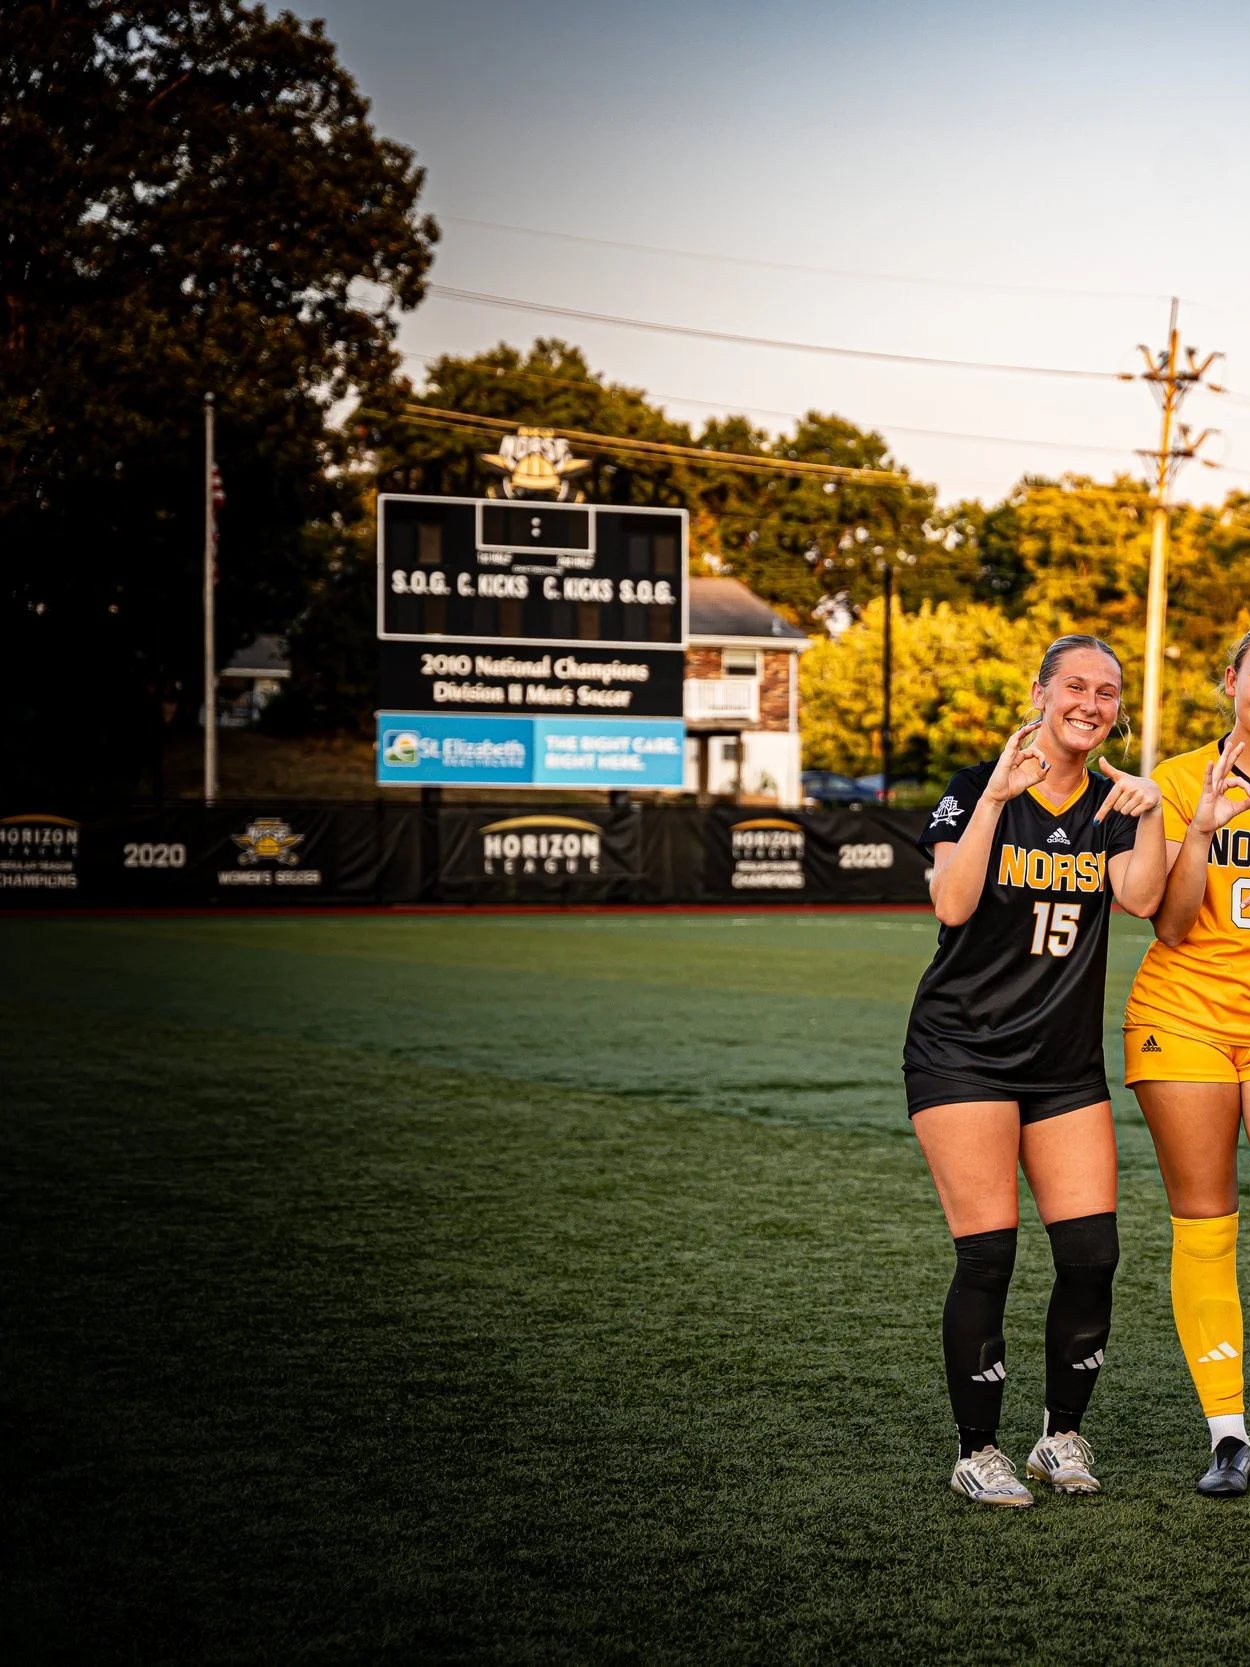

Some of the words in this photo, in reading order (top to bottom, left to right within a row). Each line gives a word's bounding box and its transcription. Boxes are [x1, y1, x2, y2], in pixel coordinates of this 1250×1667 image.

[478, 574, 529, 599] KICKS
[563, 577, 613, 602] KICKS
[421, 654, 472, 675] 2010
[475, 655, 551, 678] National
[554, 656, 649, 685] Champions
[433, 681, 505, 703] Division
[577, 685, 632, 707] Soccer
[484, 834, 600, 858] HORIZON
[1046, 837, 1071, 845] adidas
[123, 843, 186, 867] 2020
[484, 859, 600, 874] LEAGUE
[839, 843, 894, 868] 2020
[1031, 902, 1081, 957] 15
